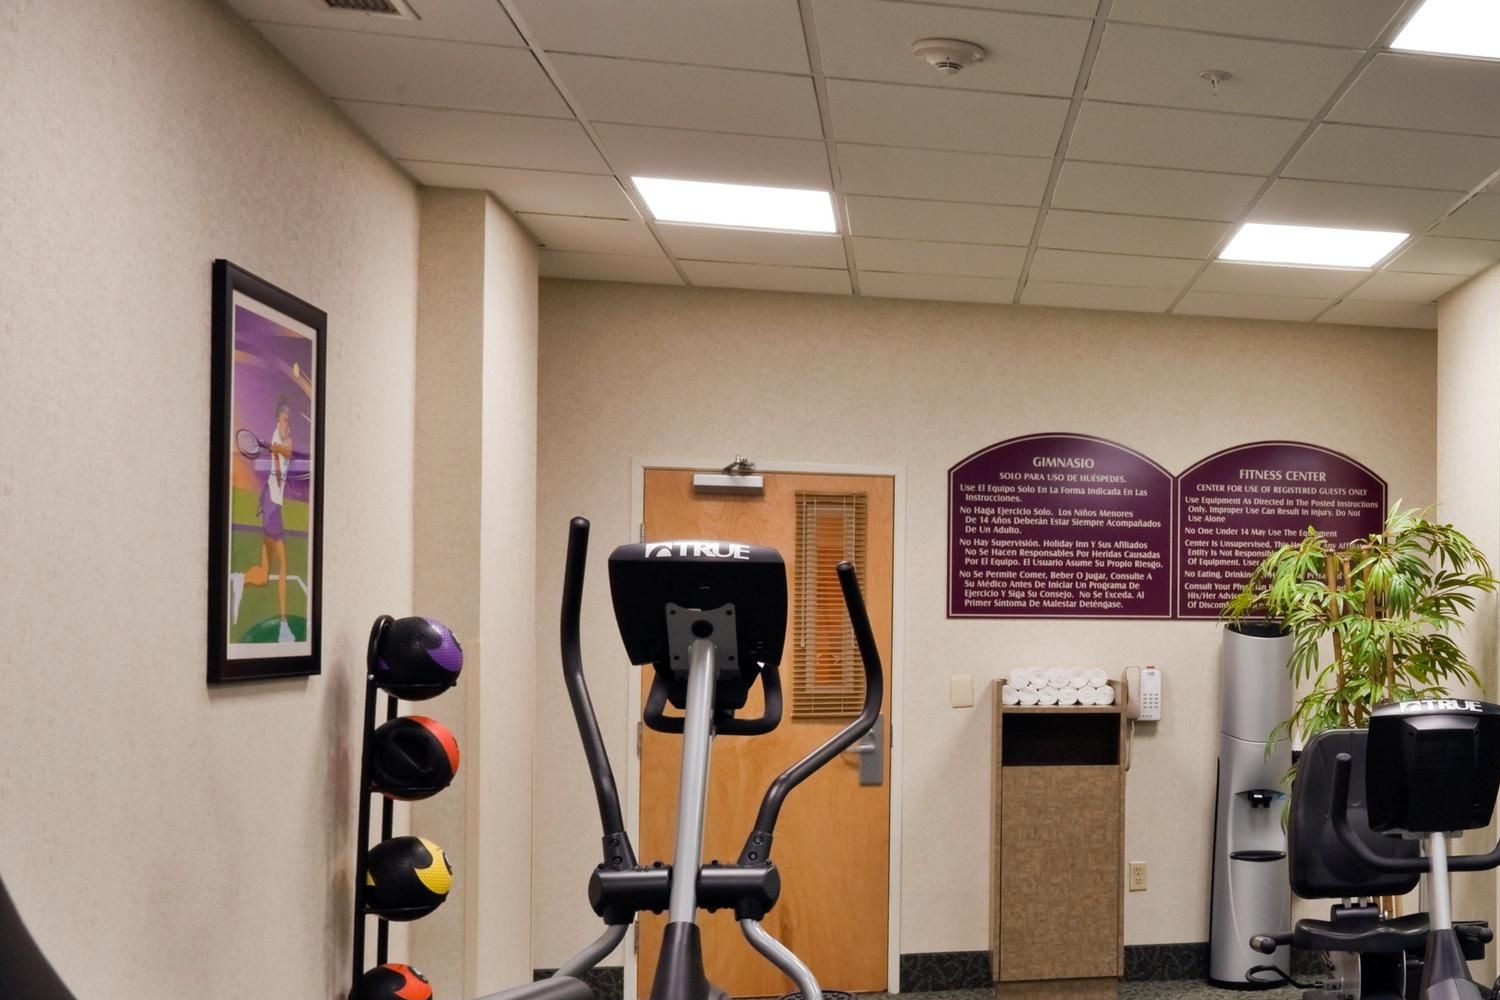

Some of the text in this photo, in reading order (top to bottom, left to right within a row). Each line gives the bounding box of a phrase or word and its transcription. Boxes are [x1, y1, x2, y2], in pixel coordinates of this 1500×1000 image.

[1033, 456, 1094, 470] GIMNASIO
[1000, 472, 1021, 481] SOLO
[1024, 473, 1044, 481] PARA
[1047, 473, 1064, 482] USO
[1066, 474, 1077, 482] DE
[1239, 469, 1325, 482] FITNESS CENTER
[960, 484, 1147, 497] Use El Equipo Solo En La Forma Indicada En Las
[1196, 484, 1367, 496] CENTER FOR USE OF REGISTERED GUESTS ONLY
[1185, 496, 1199, 504] Use
[1201, 497, 1240, 507] Equipment
[1242, 498, 1251, 506] As
[1253, 498, 1284, 506] Directed
[1296, 499, 1308, 507] The
[1310, 500, 1335, 508] Posted
[1337, 500, 1378, 508] Instructions
[960, 506, 971, 514] No
[974, 506, 994, 517] Haga
[997, 507, 1031, 518] Ejercicio
[1058, 508, 1071, 516] Los
[1074, 508, 1096, 517] Niños
[1098, 509, 1133, 518] Menores
[1209, 506, 1243, 516] Improper
[1245, 507, 1259, 515] Use
[1261, 507, 1275, 515] Can
[1277, 508, 1299, 516] Result
[1301, 508, 1308, 516] In
[1335, 509, 1345, 517] Do
[1348, 509, 1360, 517] Not
[965, 516, 1160, 530] De 14 Años Deberán Estar Siempre Acompañados
[1187, 515, 1225, 523] Use Alone
[964, 526, 976, 534] De
[979, 526, 990, 534] Un
[1184, 527, 1195, 535] No
[1215, 528, 1238, 536] Under
[1241, 528, 1248, 536] 14
[1250, 528, 1265, 538] May
[1284, 529, 1296, 537] The
[959, 538, 970, 546] No
[973, 538, 988, 549] Hay
[1043, 539, 1072, 550] Holiday
[1075, 540, 1088, 548] Inn
[1091, 540, 1095, 548] Y
[1097, 540, 1111, 549] Sus
[1114, 540, 1147, 549] Afiliados
[1211, 540, 1217, 548] Is
[672, 541, 750, 560] TRUE
[965, 548, 1160, 560] No Se Hacen Responsables Por Heridas Causadas
[1187, 549, 1278, 560] Entity Is Not Responsibl
[964, 557, 978, 566] Por
[981, 558, 988, 566] El
[1023, 558, 1030, 566] El
[1032, 558, 1063, 567] Usuario
[1065, 559, 1092, 567] Asume
[1094, 559, 1104, 567] Su
[1106, 559, 1132, 570] Propio
[1187, 558, 1196, 566] Of
[959, 570, 970, 578] No
[973, 570, 983, 578] Se
[985, 570, 1016, 579] Permite
[1050, 571, 1073, 580] Beber
[1076, 571, 1083, 580] O
[1110, 572, 1144, 580] Consulte
[1146, 572, 1152, 580] A
[1184, 570, 1195, 578] No
[964, 580, 1139, 591] Su Médico Antes De Iniciar Un Programa De
[1184, 583, 1212, 591] Consult
[1214, 583, 1230, 591] Your
[964, 589, 998, 600] Ejercicio
[1001, 590, 1005, 598] Y
[1008, 590, 1025, 600] Siga
[1027, 590, 1037, 598] Su
[1079, 590, 1090, 599] No
[1092, 590, 1102, 599] Se
[1136, 591, 1144, 599] Al
[1187, 592, 1215, 601] His/Her
[964, 599, 990, 607] Primer
[994, 599, 1026, 607] Síntoma
[1029, 599, 1040, 608] De
[1042, 599, 1076, 608] Malestar
[1421, 699, 1483, 713] TRUE
